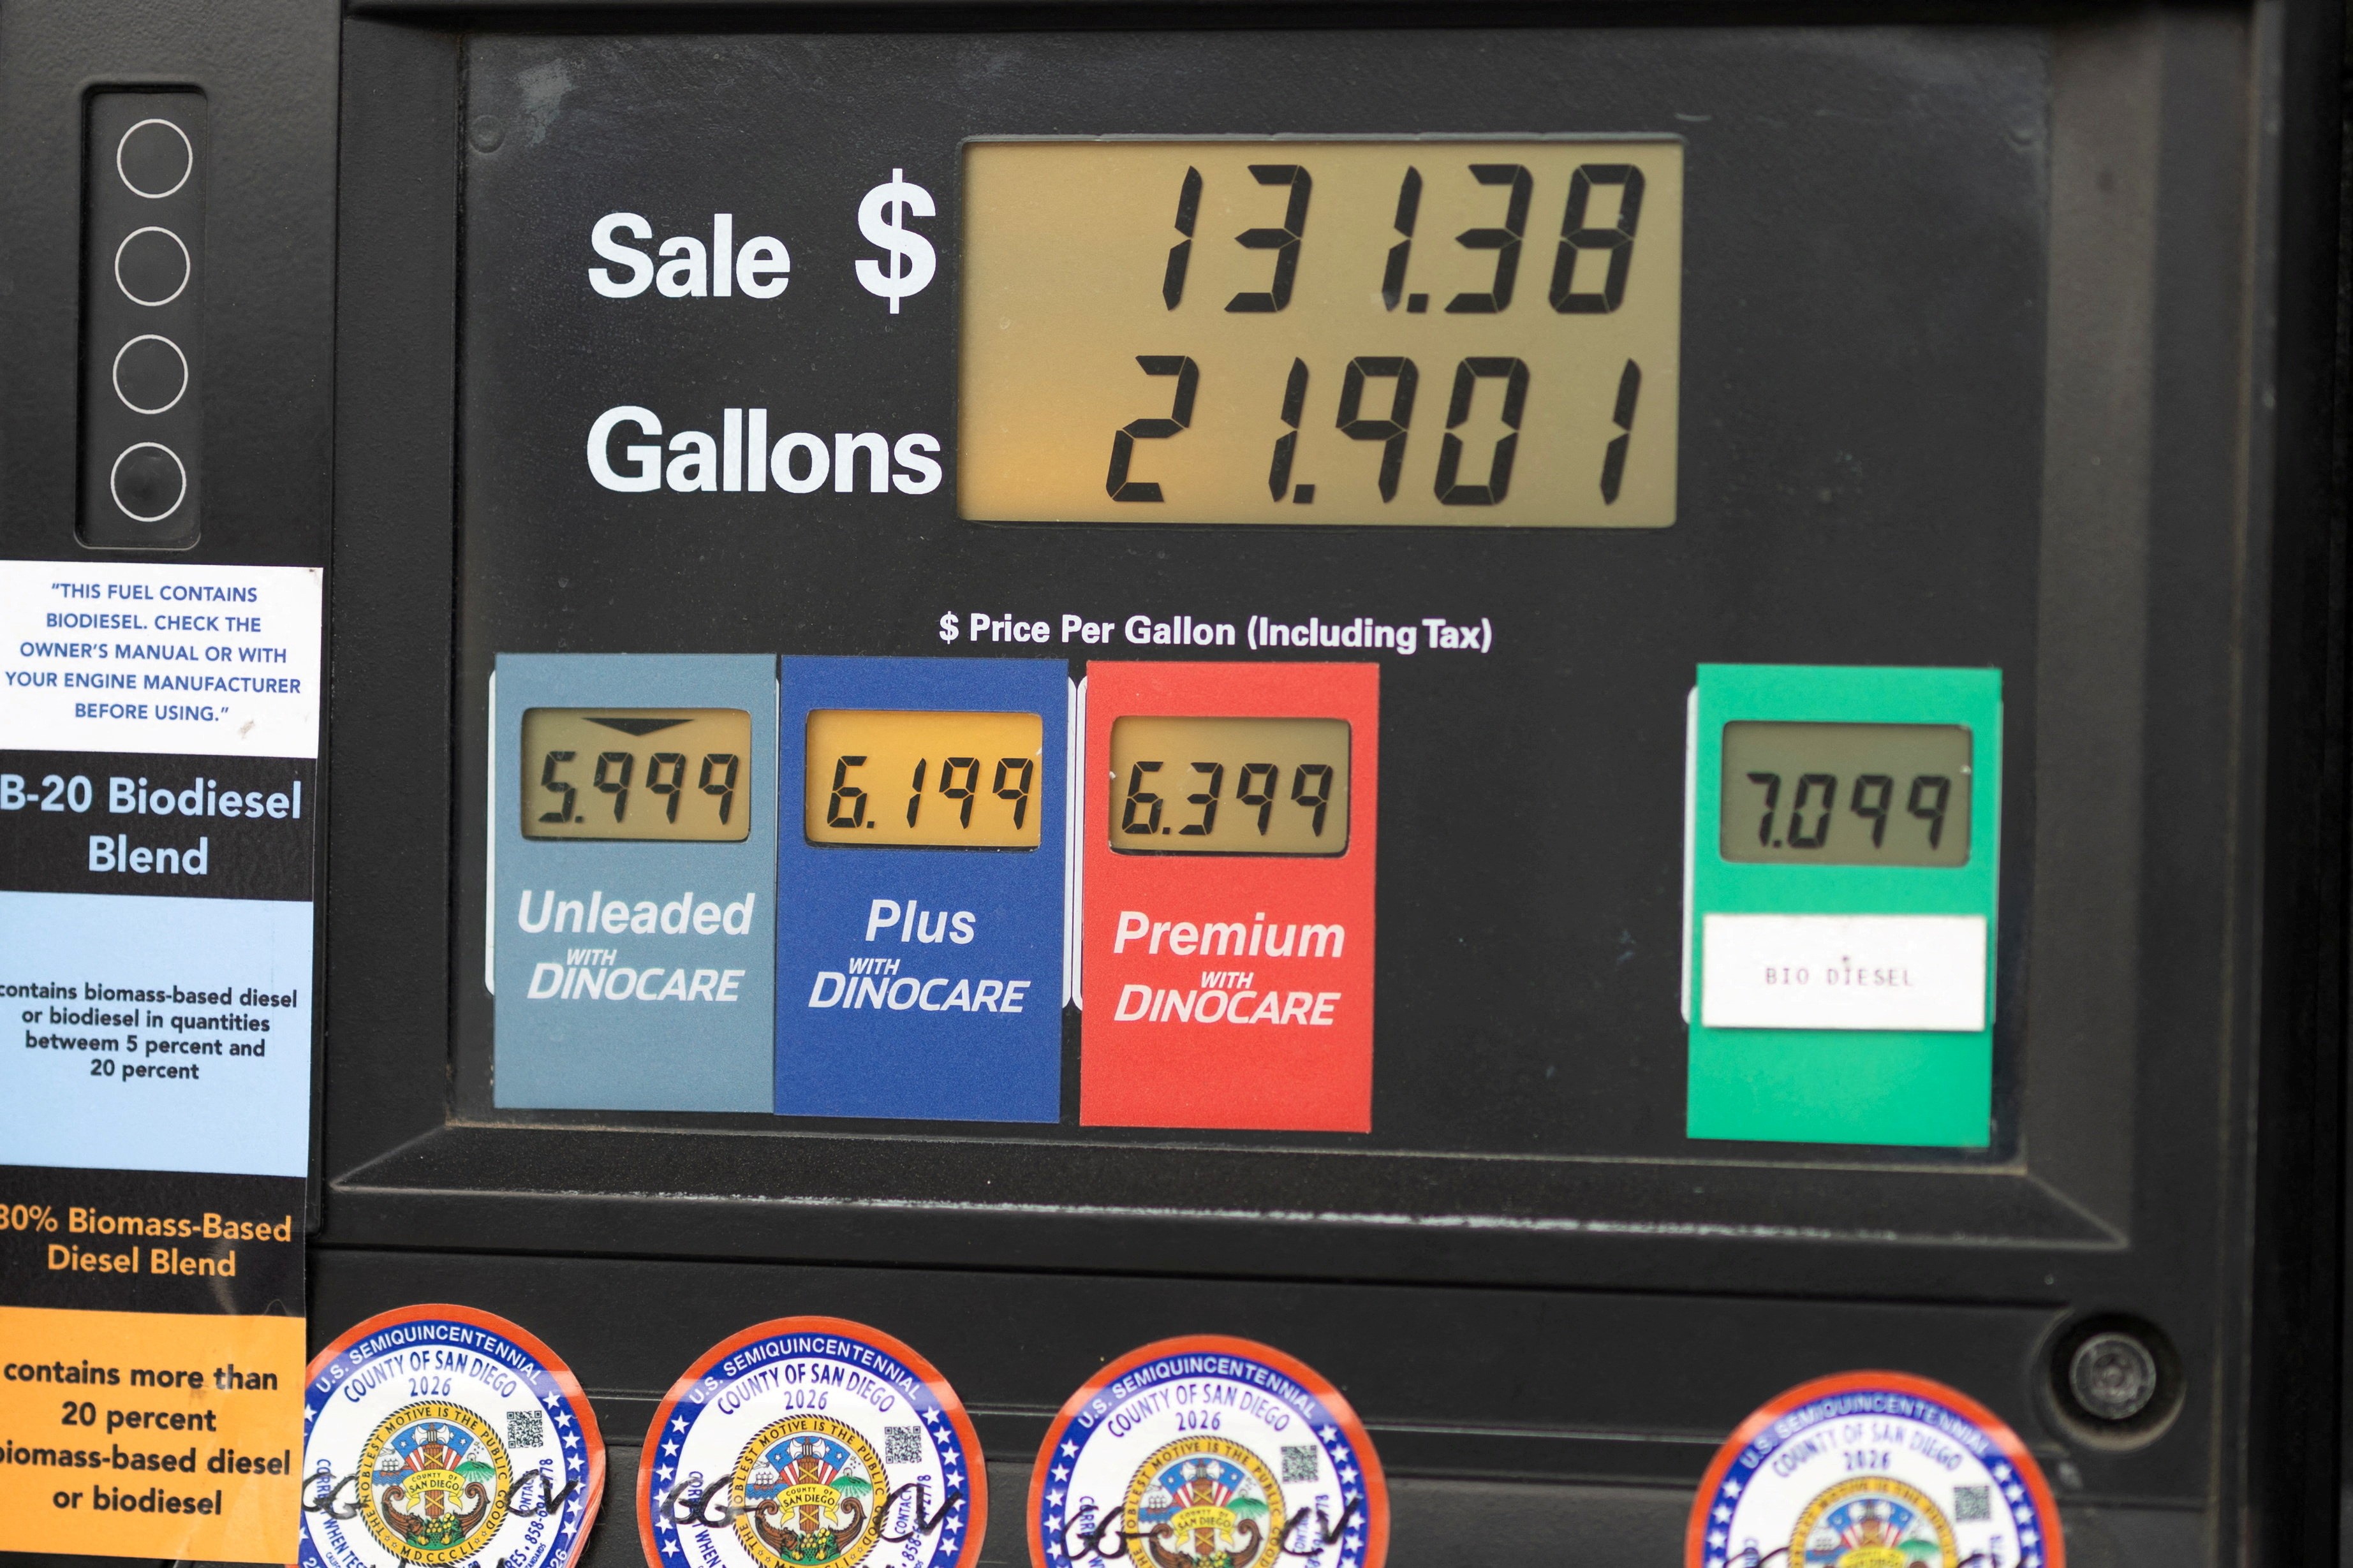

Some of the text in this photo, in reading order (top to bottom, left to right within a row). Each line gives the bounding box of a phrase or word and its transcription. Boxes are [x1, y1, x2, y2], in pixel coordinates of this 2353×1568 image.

[588, 168, 936, 314] Sale $
[1162, 164, 1644, 314] 131.38
[1105, 355, 1641, 506] 21.901
[587, 406, 942, 494] Gallons
[108, 585, 154, 600] FUEL
[160, 585, 258, 602] CONTAINS
[47, 613, 262, 633] BIODIESEL. CHECK THE
[939, 610, 1492, 655] $ Price Per Gallon (Including Tax)
[20, 642, 286, 663] OWNER’S MANUAL OR WITH
[6, 671, 300, 694] YOUR ENGINE MANUFACTURER
[75, 703, 147, 720] BEFORE
[0, 773, 301, 819] B-20 Biodiesel
[538, 751, 739, 826] 5.999
[827, 756, 1034, 831] 6.199
[1122, 761, 1333, 837] 6.399
[1746, 772, 1951, 851] 7.099
[89, 833, 209, 874] Blend
[518, 890, 755, 935] Unleaded
[866, 900, 976, 944] Plus
[1114, 911, 1345, 958] Premium
[566, 949, 617, 967] WITH
[849, 958, 900, 976] WITH
[527, 962, 746, 1002] DINOCARE
[808, 972, 1031, 1013] DINOCARE
[1201, 971, 1253, 989] WITH
[1766, 967, 1914, 986] BIO DIESEL
[85, 983, 232, 1005] biomass-based
[240, 988, 297, 1007] diesel
[1114, 984, 1341, 1025] DINOCARE
[22, 1006, 270, 1033] or biodiesel in quantities
[26, 1030, 265, 1057] betweem 5 percent and
[90, 1059, 199, 1081] 20 percent
[68, 1207, 291, 1242] Biomass-Based
[48, 1244, 236, 1277] Diesel Blend
[4, 1359, 278, 1390] contains more than
[316, 1324, 542, 1394] U.S. SEMIQUINCENTENNIAL
[688, 1338, 921, 1405] U.S. SEMIQUINCENTENNIAL
[344, 1349, 517, 1402] COUNTY OF SAN DIEGO
[408, 1376, 452, 1398] 2026
[717, 1363, 897, 1416] COUNTY OF SAN DIEGO
[784, 1389, 828, 1410] 2026
[1079, 1356, 1314, 1430] U.S. SEMIQUINCENTENNIAL
[61, 1402, 217, 1434] 20 percent
[385, 1407, 432, 1434] MOTIVE
[438, 1407, 449, 1418] IS
[455, 1410, 478, 1430] THE
[813, 1420, 825, 1431] IS
[1108, 1383, 1290, 1438] COUNTY OF SAN DIEGO
[1176, 1410, 1221, 1431] 2026
[759, 1420, 808, 1447] MOTIVE
[832, 1425, 855, 1444] THE
[207, 1449, 291, 1475] diesel
[480, 1431, 508, 1481] PUBLIC
[1771, 1422, 1963, 1478] COUNTY OF SAN DIEGO
[409, 1479, 459, 1493] SAN DIEGO
[411, 1473, 441, 1483] COUNTY
[734, 1447, 758, 1505] OBLEST
[857, 1446, 885, 1496] PUBLIC
[1126, 1471, 1149, 1528] OBLEST
[1152, 1442, 1200, 1470] MOTIVE
[1207, 1442, 1219, 1453] IS
[1225, 1446, 1250, 1466] THE
[1253, 1466, 1282, 1518] PUBLIC
[53, 1484, 222, 1515] or biodiesel
[783, 1493, 835, 1508] SAN DIEGO
[786, 1486, 816, 1497] COUNTY
[366, 1509, 385, 1536] THE
[486, 1490, 507, 1530] GOOD
[1177, 1516, 1232, 1532] SAN DIEGO
[323, 1517, 350, 1555] WHEN
[695, 1529, 721, 1568] WHEN
[739, 1523, 758, 1550] THE
